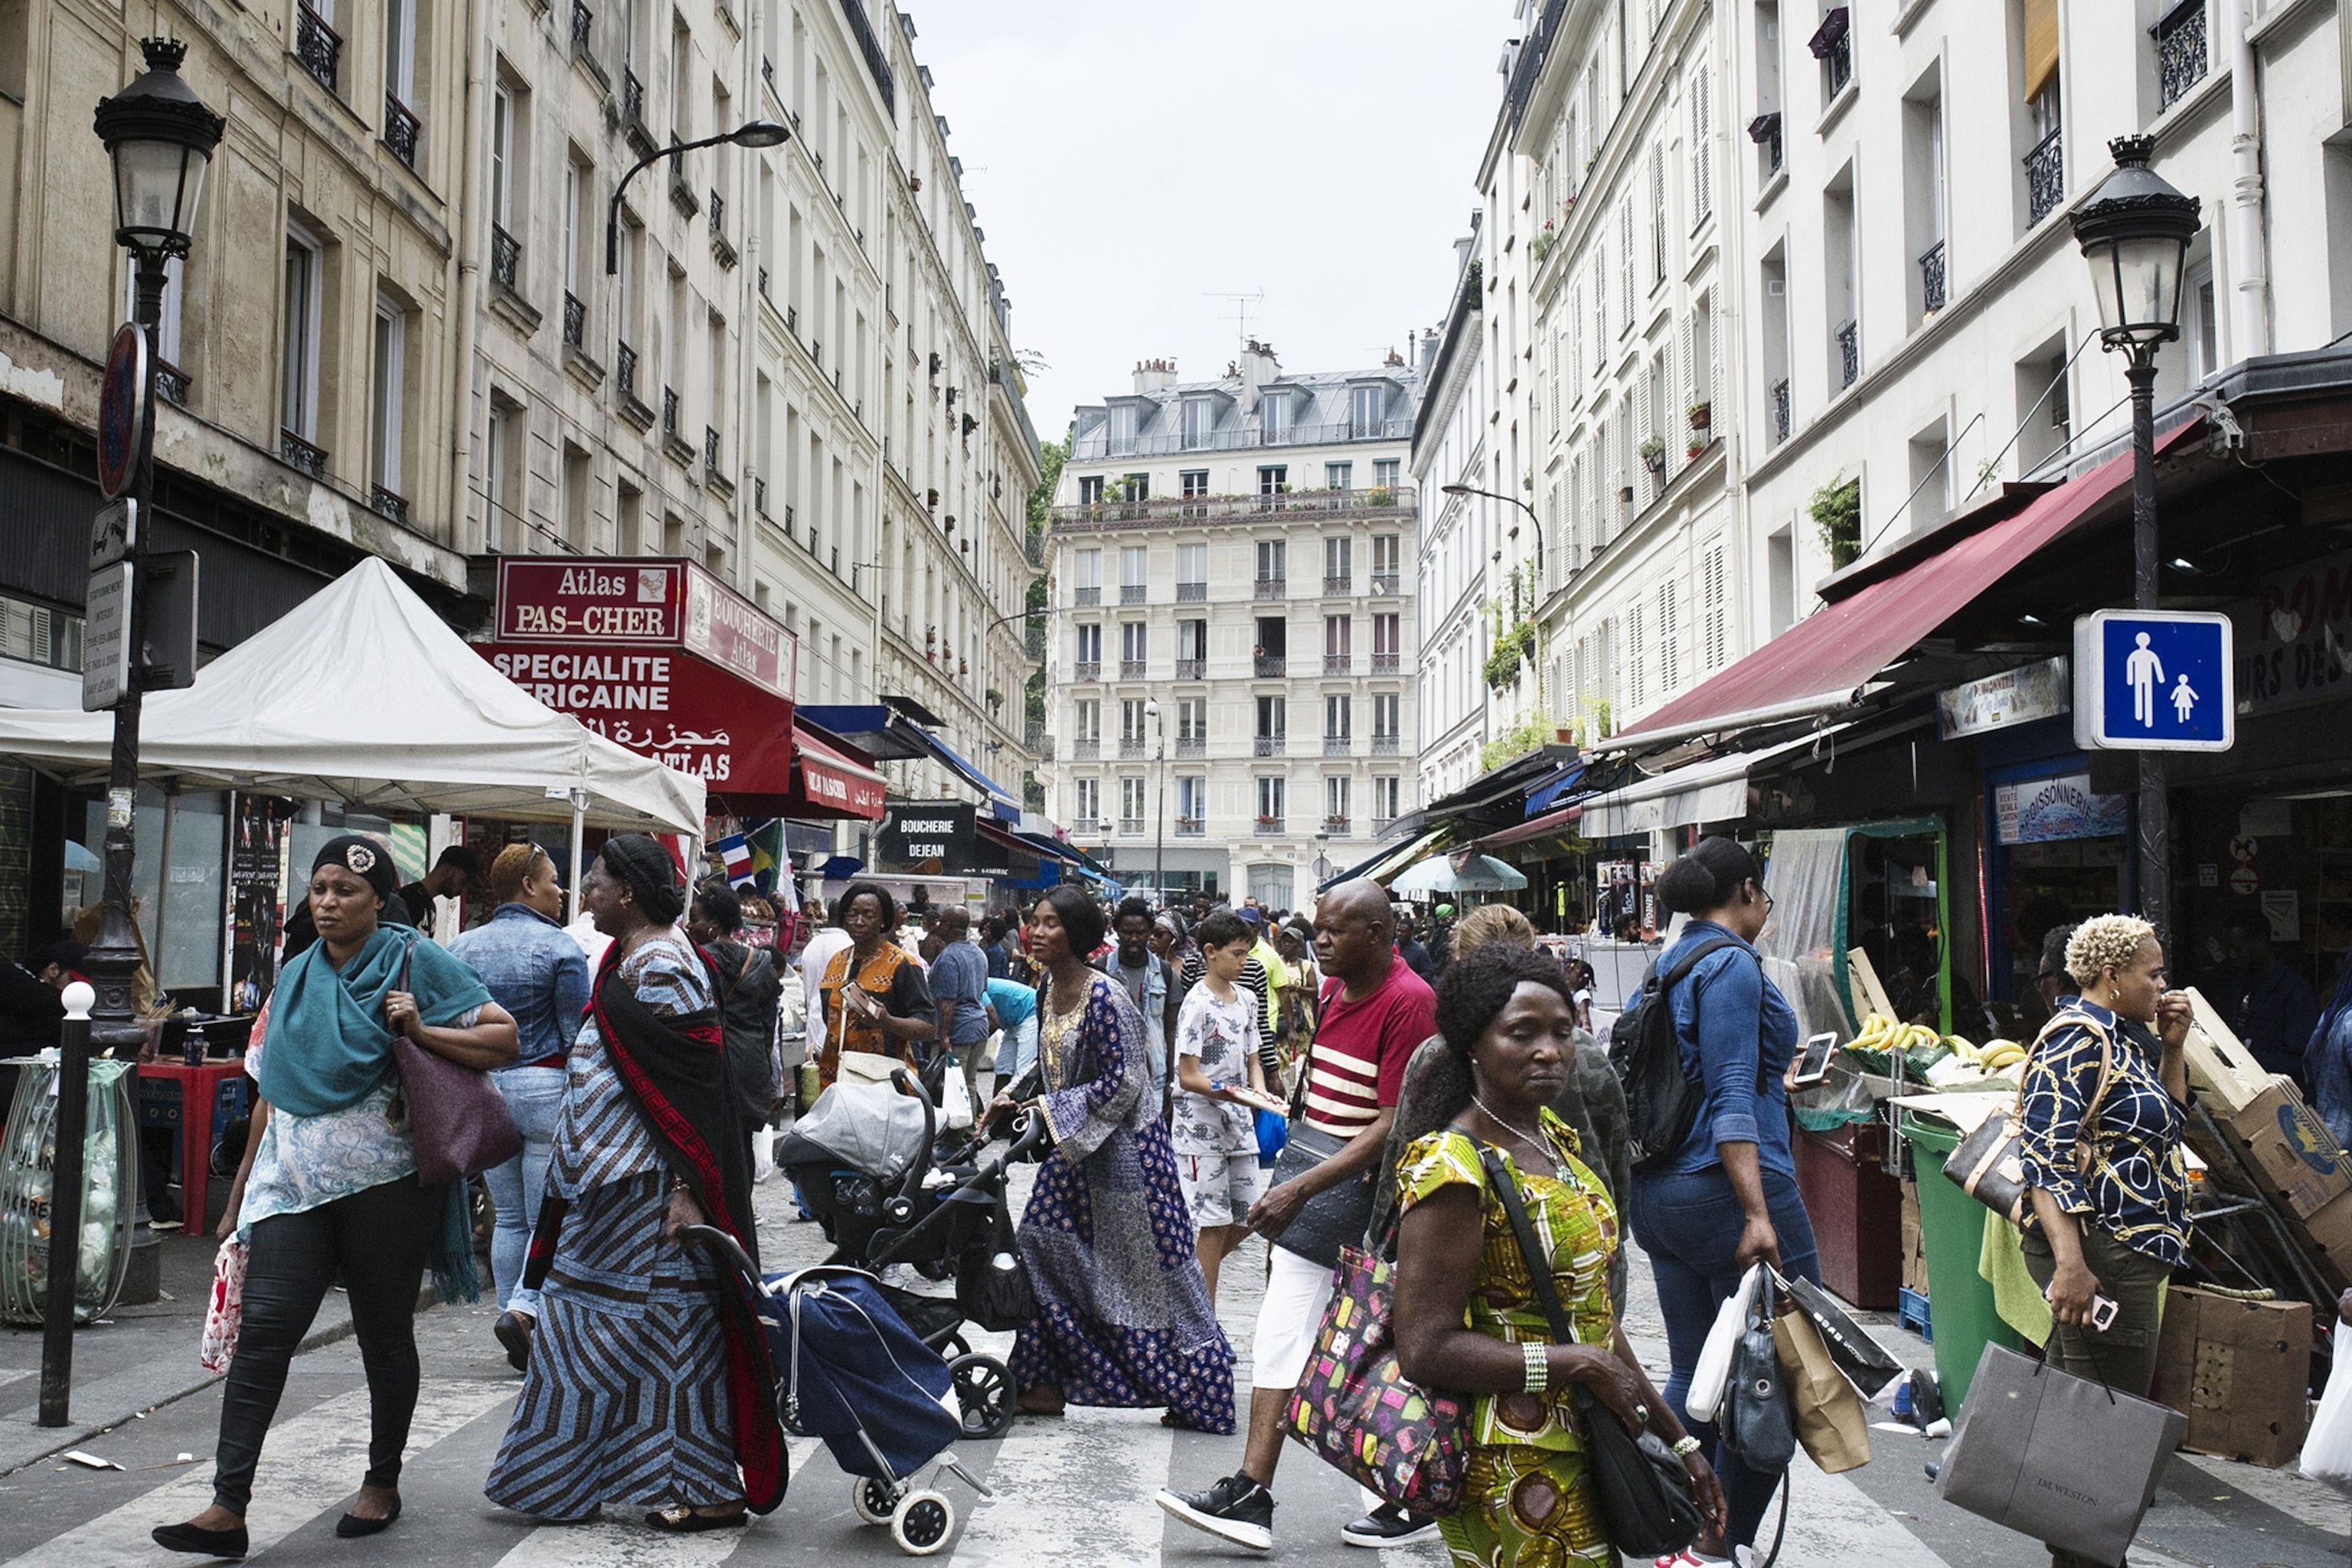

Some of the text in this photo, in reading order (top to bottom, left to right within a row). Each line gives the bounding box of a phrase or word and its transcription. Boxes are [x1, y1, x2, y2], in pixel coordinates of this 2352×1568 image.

[557, 568, 626, 596] Atlas
[515, 605, 665, 636] PAS-CHER
[714, 590, 777, 655] BOUCHERIE
[493, 653, 670, 682] SPECIALITE
[731, 636, 757, 674] Atlas
[518, 683, 669, 710] RICAINE
[2000, 792, 2017, 802] VENTE
[2024, 784, 2092, 832] POISSONNERIE
[900, 820, 954, 834] BOUCHERIE
[2001, 812, 2018, 822] CARTON
[909, 844, 945, 858] DEJEAN
[1644, 893, 1654, 929] SENEGAL
[890, 1152, 903, 1165] Joie
[2055, 1485, 2099, 1507] WESTON
